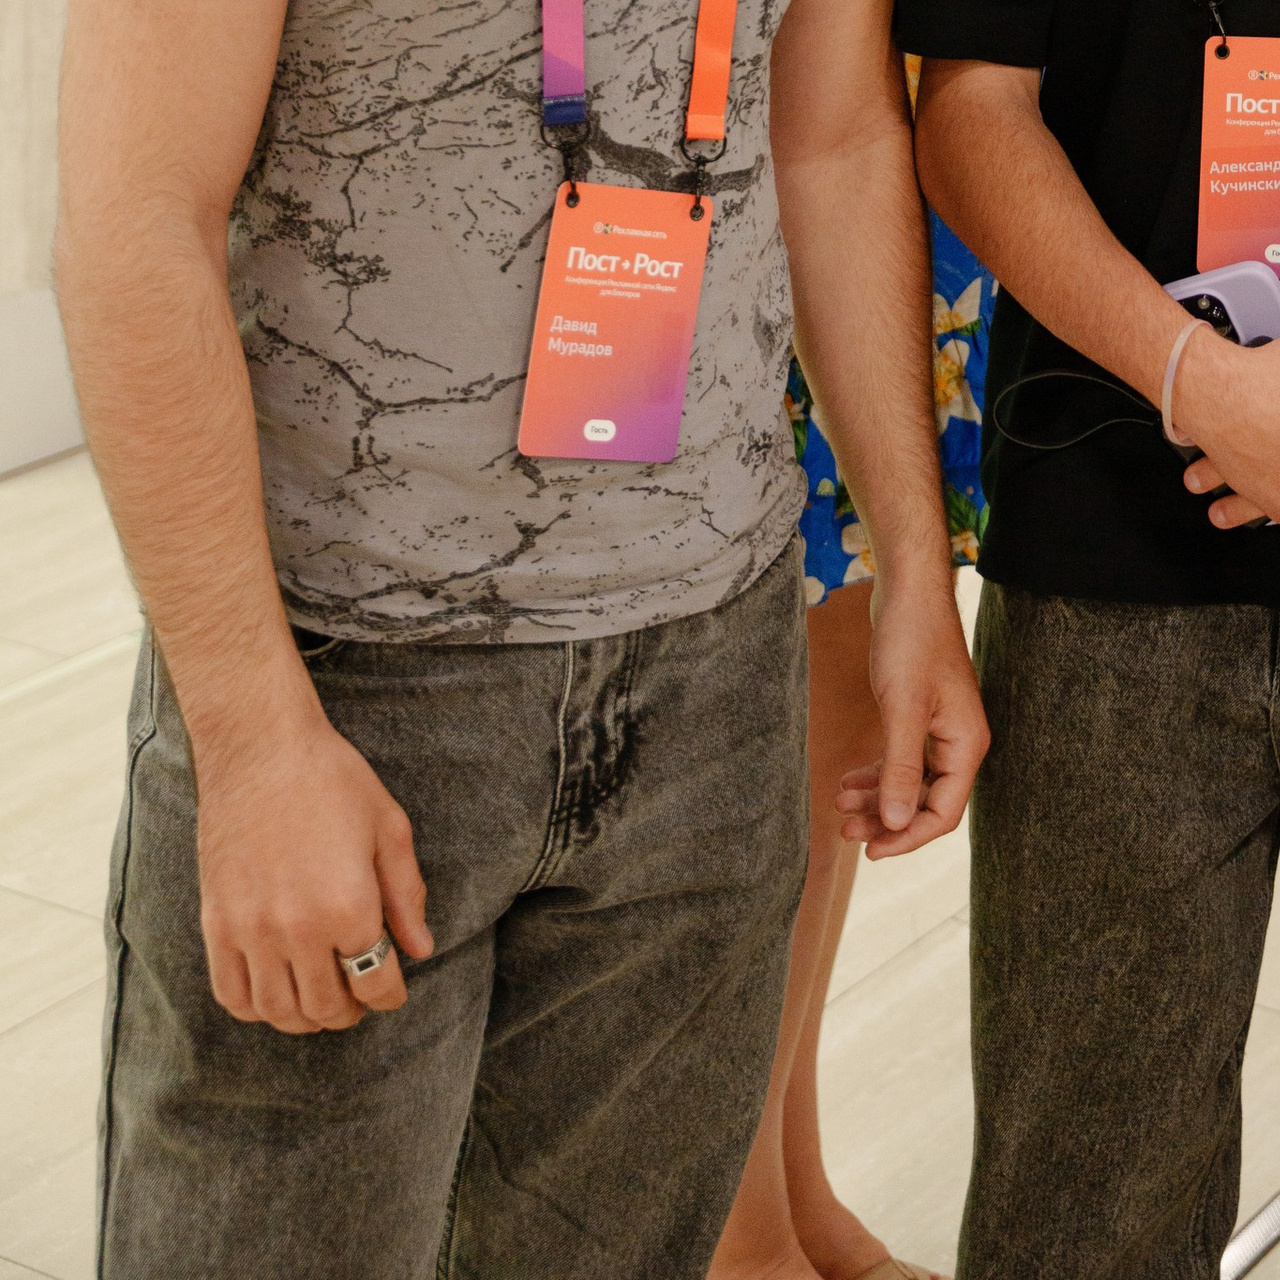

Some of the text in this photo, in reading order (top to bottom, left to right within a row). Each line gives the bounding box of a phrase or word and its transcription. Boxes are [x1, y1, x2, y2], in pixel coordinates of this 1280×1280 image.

[1225, 92, 1280, 114] Пост
[566, 246, 684, 279] Пост Рост
[550, 314, 598, 335] Давид
[548, 337, 613, 357] Мурадов
